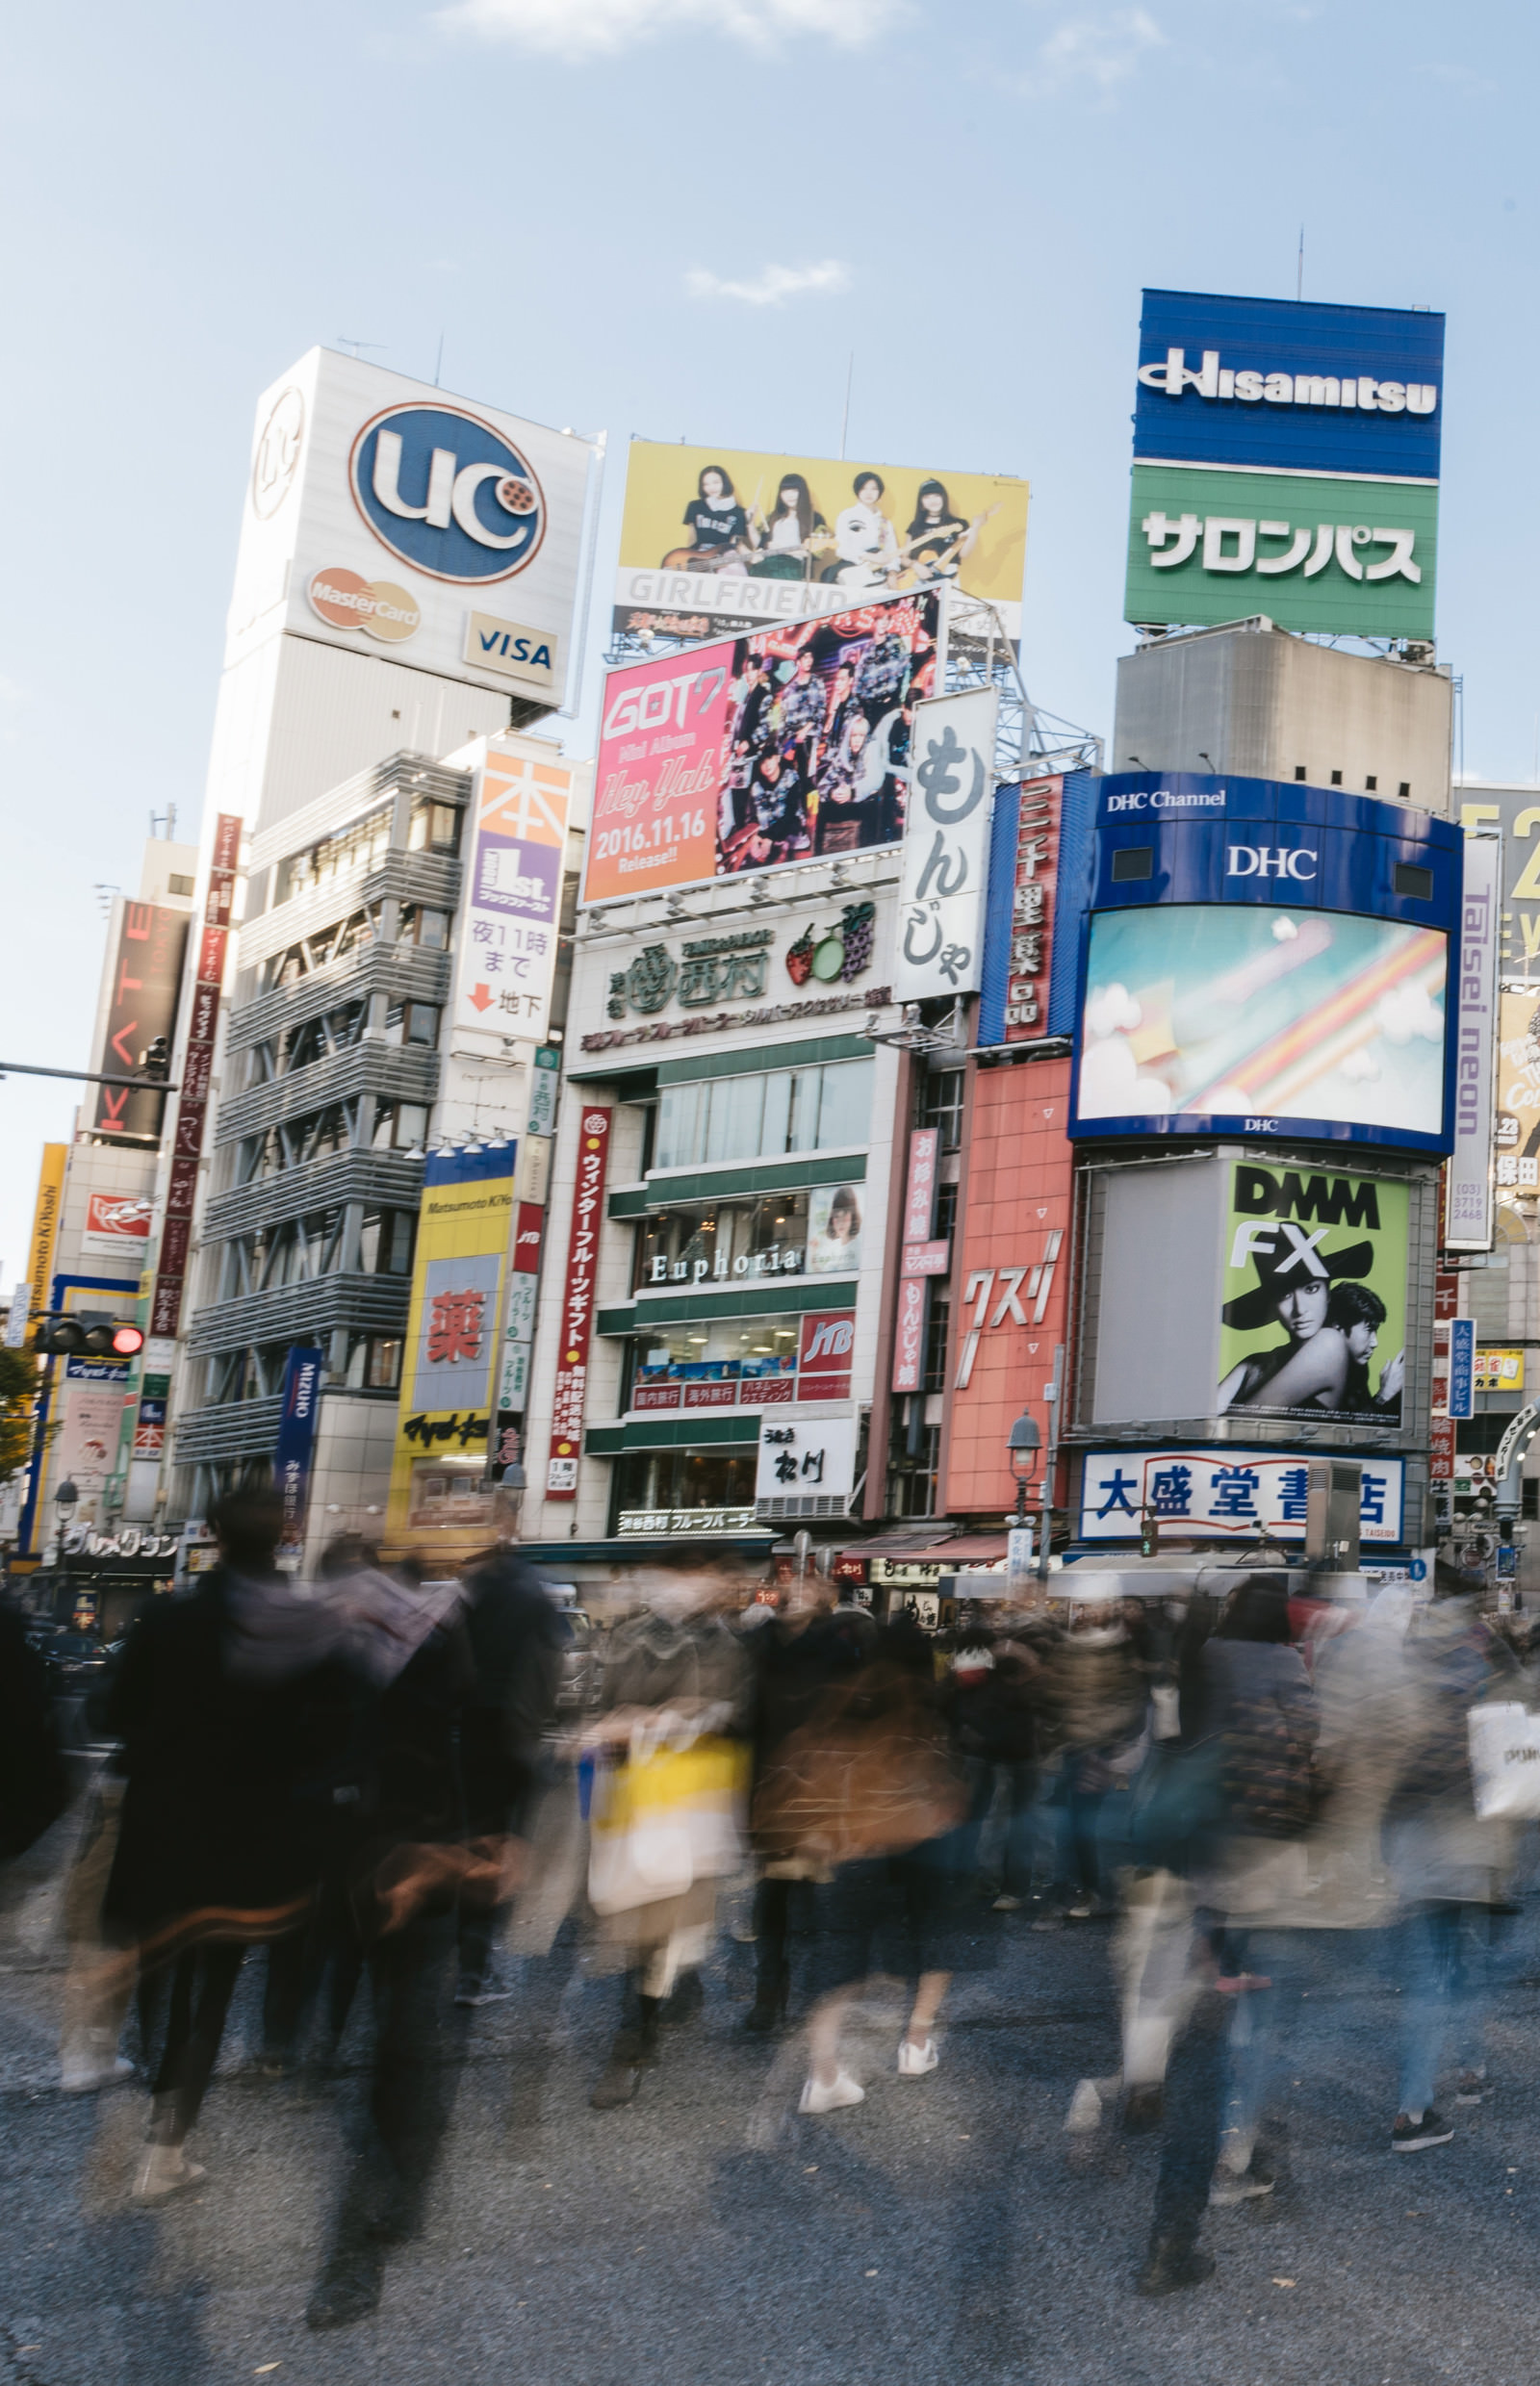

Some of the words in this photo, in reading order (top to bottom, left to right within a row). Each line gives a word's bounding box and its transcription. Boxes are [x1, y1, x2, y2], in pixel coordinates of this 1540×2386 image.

[1138, 348, 1437, 415] Hisamitsu
[1142, 511, 1422, 583] サロンパス
[311, 580, 421, 627] MasterCard
[479, 629, 552, 671] VISA
[603, 666, 727, 740] GOT7
[649, 731, 696, 757] Album
[1108, 793, 1148, 811] DHC
[1150, 790, 1225, 808] Channel
[596, 808, 706, 860] 2016.11.16
[618, 846, 678, 874] Release!!
[904, 726, 986, 987] もんじゃ
[1227, 846, 1318, 880] DHC
[479, 889, 551, 913] ブックファースト
[473, 919, 550, 956] 夜11時
[1461, 884, 1491, 1013] Taisei
[485, 951, 532, 979] まで
[499, 989, 542, 1018] 地下
[1458, 1027, 1480, 1135] neon
[1245, 1118, 1278, 1132] DHC
[1234, 1166, 1381, 1230] DMM
[1454, 1197, 1483, 1208] 3719
[1456, 1183, 1482, 1196] (03)
[1453, 1209, 1483, 1220] 2468
[517, 1230, 541, 1244] JTB
[1230, 1220, 1330, 1278] FX
[650, 1244, 797, 1286] Euphoria
[427, 1288, 486, 1364] 薬
[803, 1320, 855, 1363] JTB
[636, 1390, 679, 1406] 国内旅行
[687, 1387, 734, 1403] 海外旅行
[745, 1379, 789, 1393] ハネムーン
